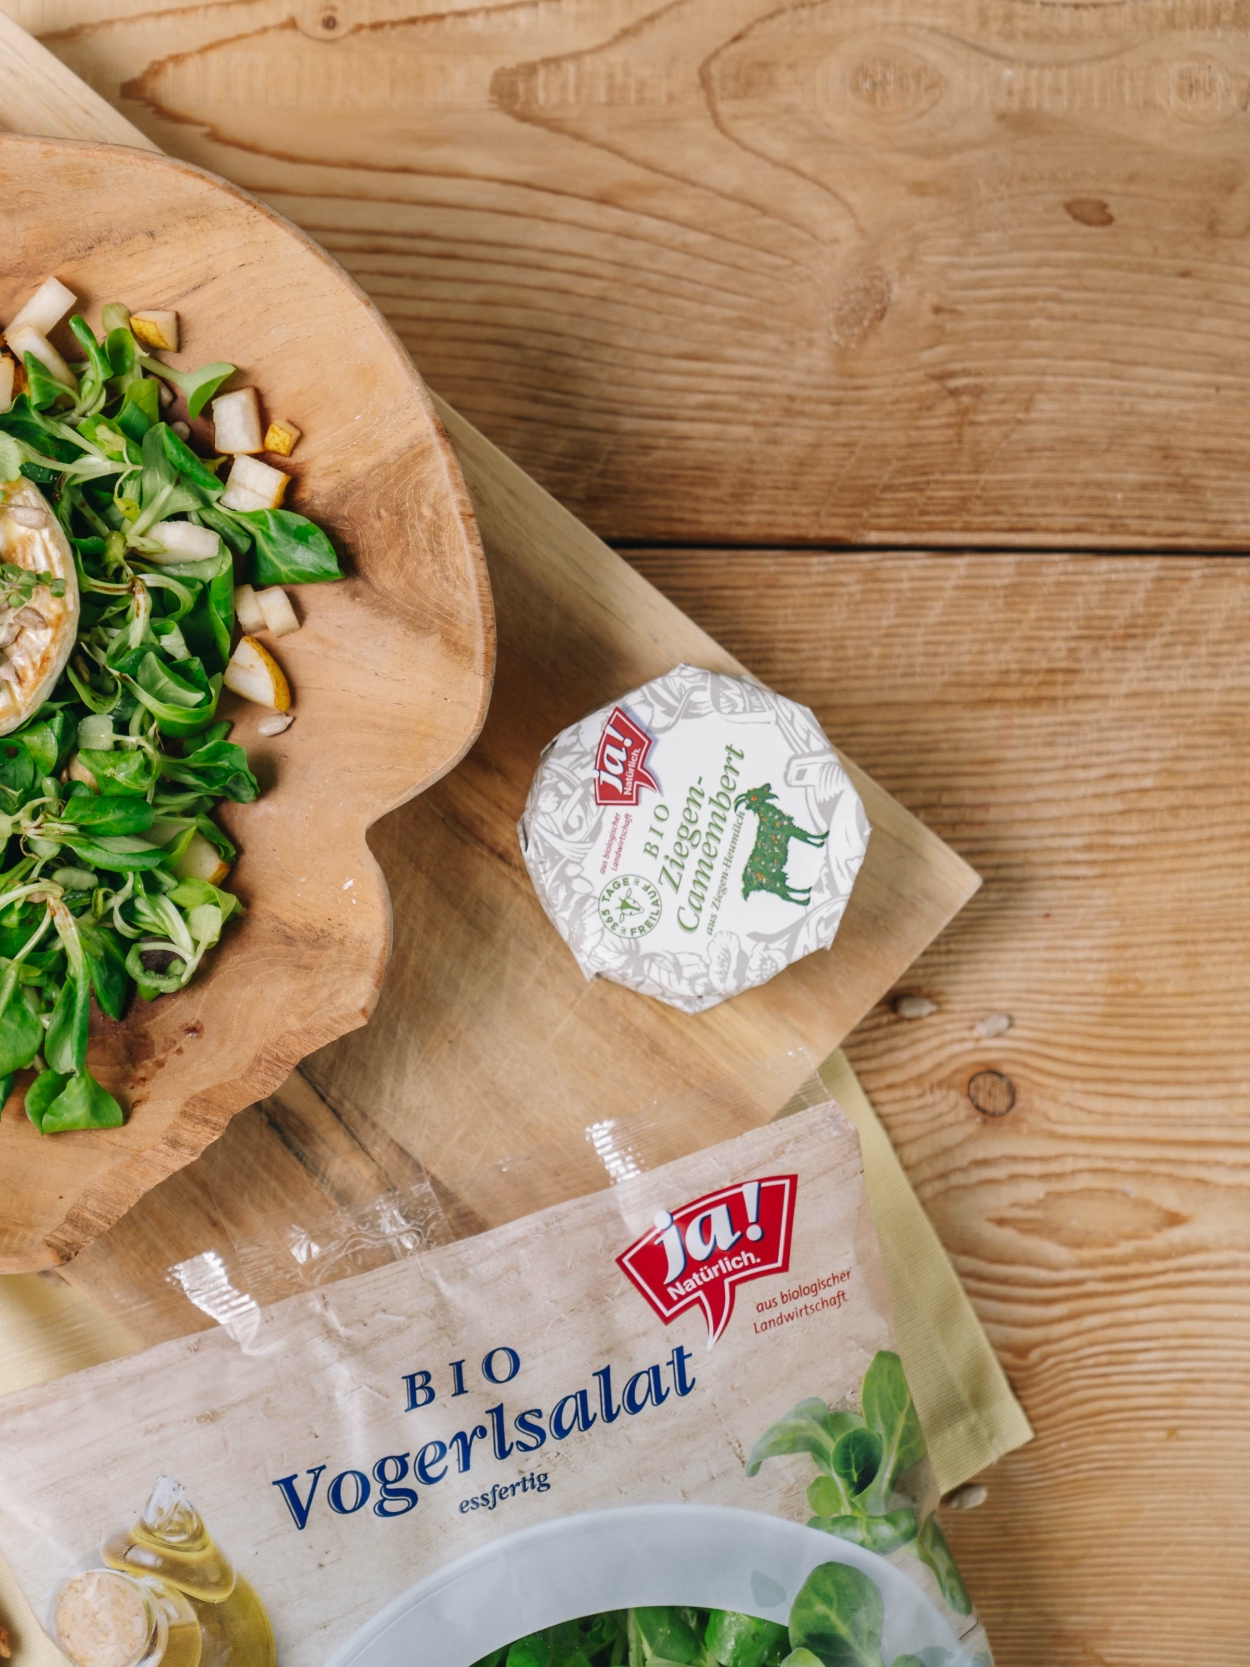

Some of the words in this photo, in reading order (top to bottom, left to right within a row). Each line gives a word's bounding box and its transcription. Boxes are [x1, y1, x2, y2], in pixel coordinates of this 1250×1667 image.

[593, 724, 633, 795] ja!
[602, 812, 621, 860] biologischer
[610, 813, 633, 871] Landwirtschaft
[642, 804, 670, 861] BIO
[657, 775, 705, 894] Ziegen-
[677, 743, 745, 934] Camembert
[600, 860, 608, 875] aus
[711, 810, 745, 912] Ziegen-Heumilch
[601, 877, 630, 902] TAGE
[630, 884, 660, 937] FREILAUF
[601, 909, 619, 931] 365
[706, 913, 717, 936] aus
[654, 1181, 765, 1285] ja!
[666, 1251, 761, 1301] Natürlich.
[756, 1299, 778, 1313] aus
[780, 1269, 851, 1305] biologischer
[753, 1290, 848, 1334] Landwirtschaft
[401, 1346, 521, 1413] BIO
[272, 1345, 697, 1531] Vogerlsalat
[458, 1471, 551, 1514] essfertig
